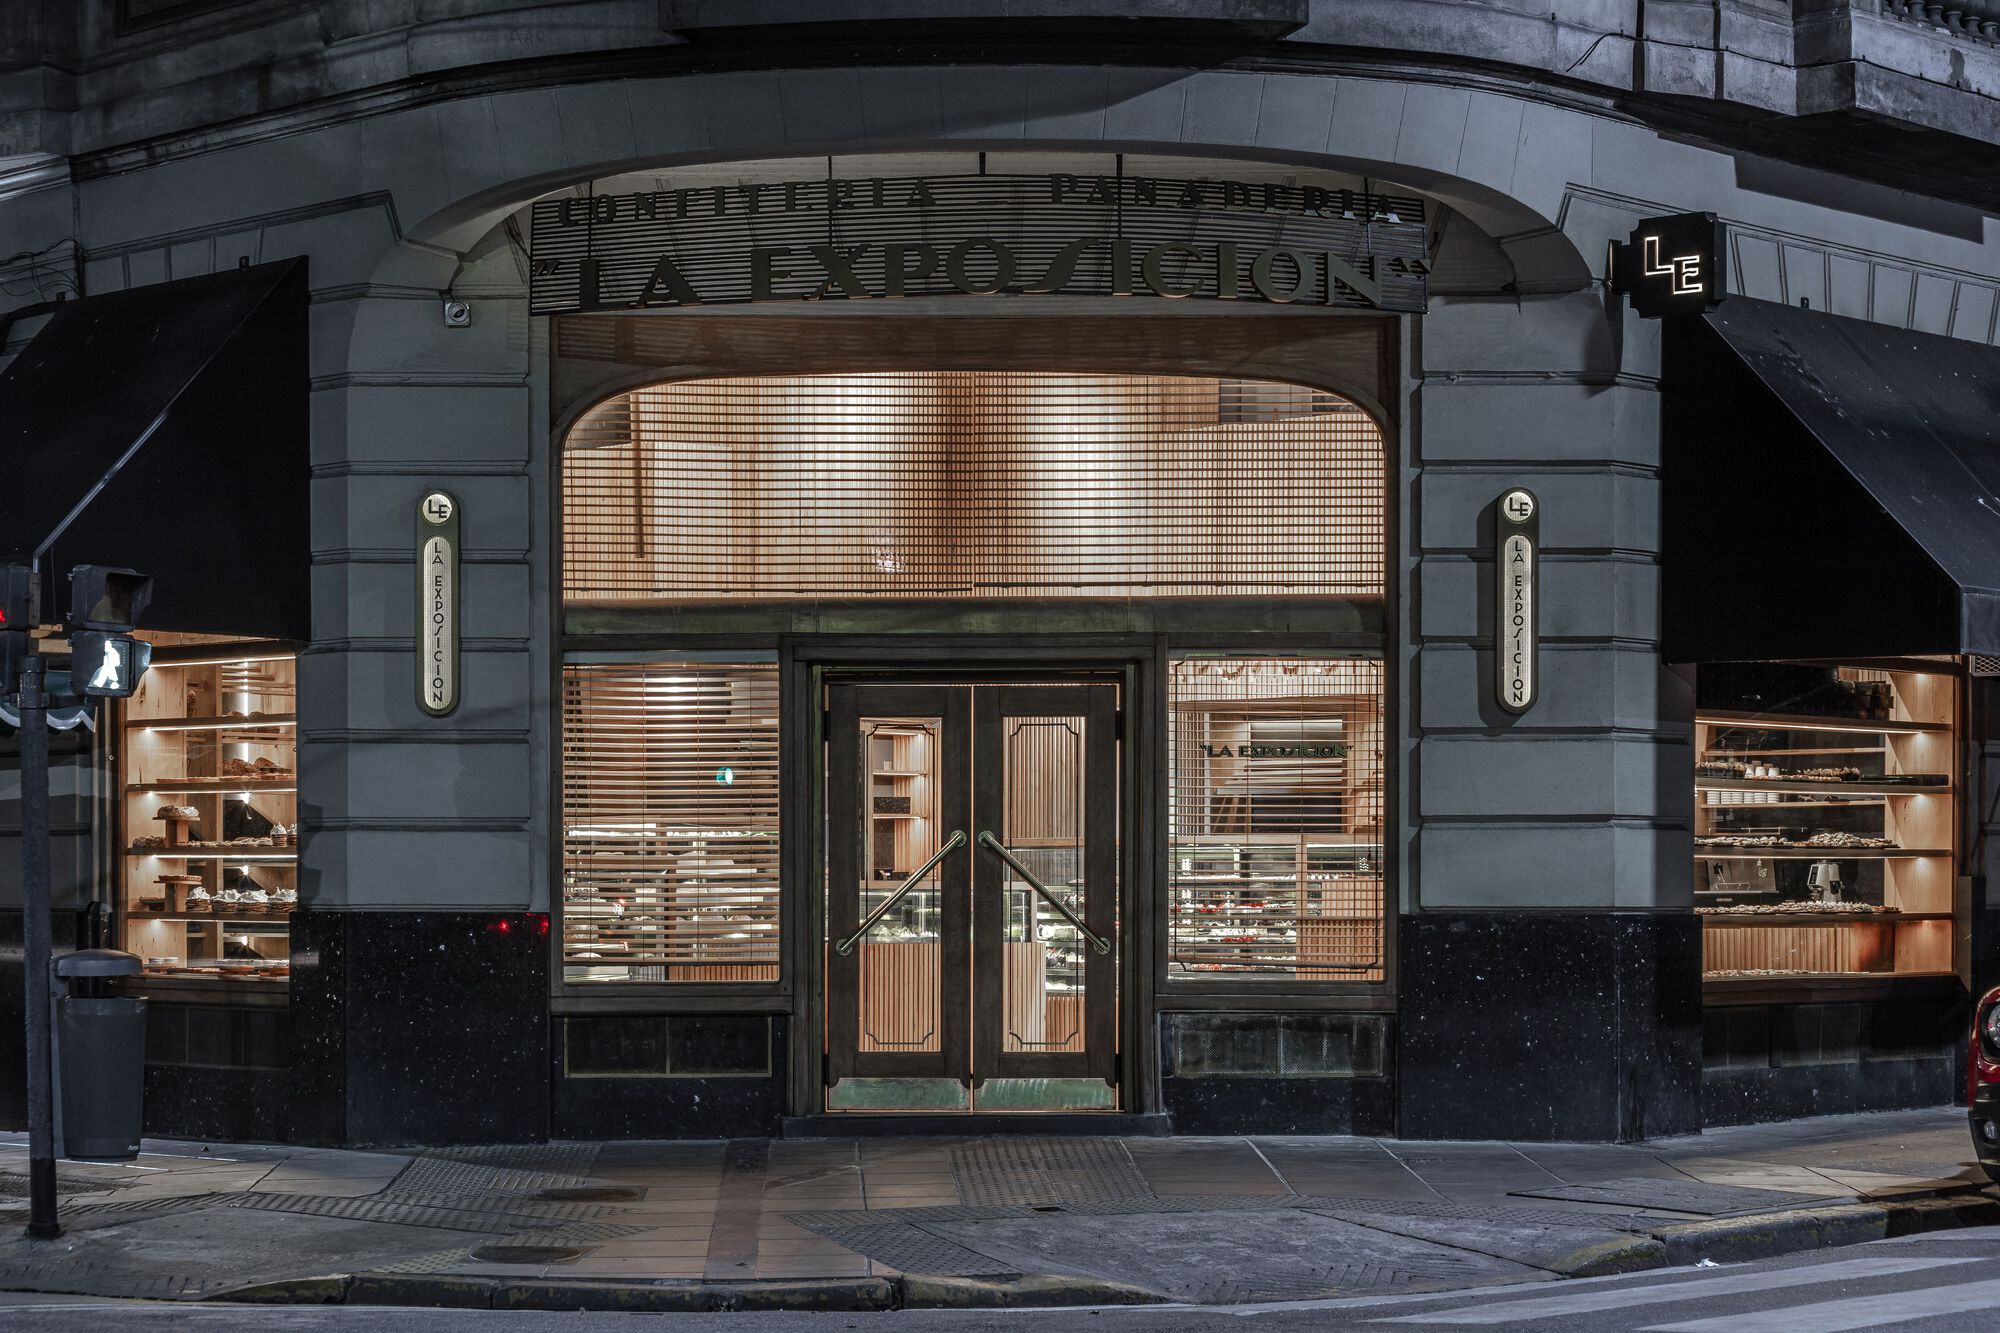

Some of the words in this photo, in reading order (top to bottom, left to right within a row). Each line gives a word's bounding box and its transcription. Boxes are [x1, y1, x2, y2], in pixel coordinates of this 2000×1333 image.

[558, 177, 937, 226] CONFITERIA
[1050, 173, 1402, 224] PANADERIA
[432, 542, 443, 565] LA
[1513, 540, 1525, 563] LA
[432, 576, 444, 702] EXPOSICION
[1513, 575, 1524, 702] EXPOSICION
